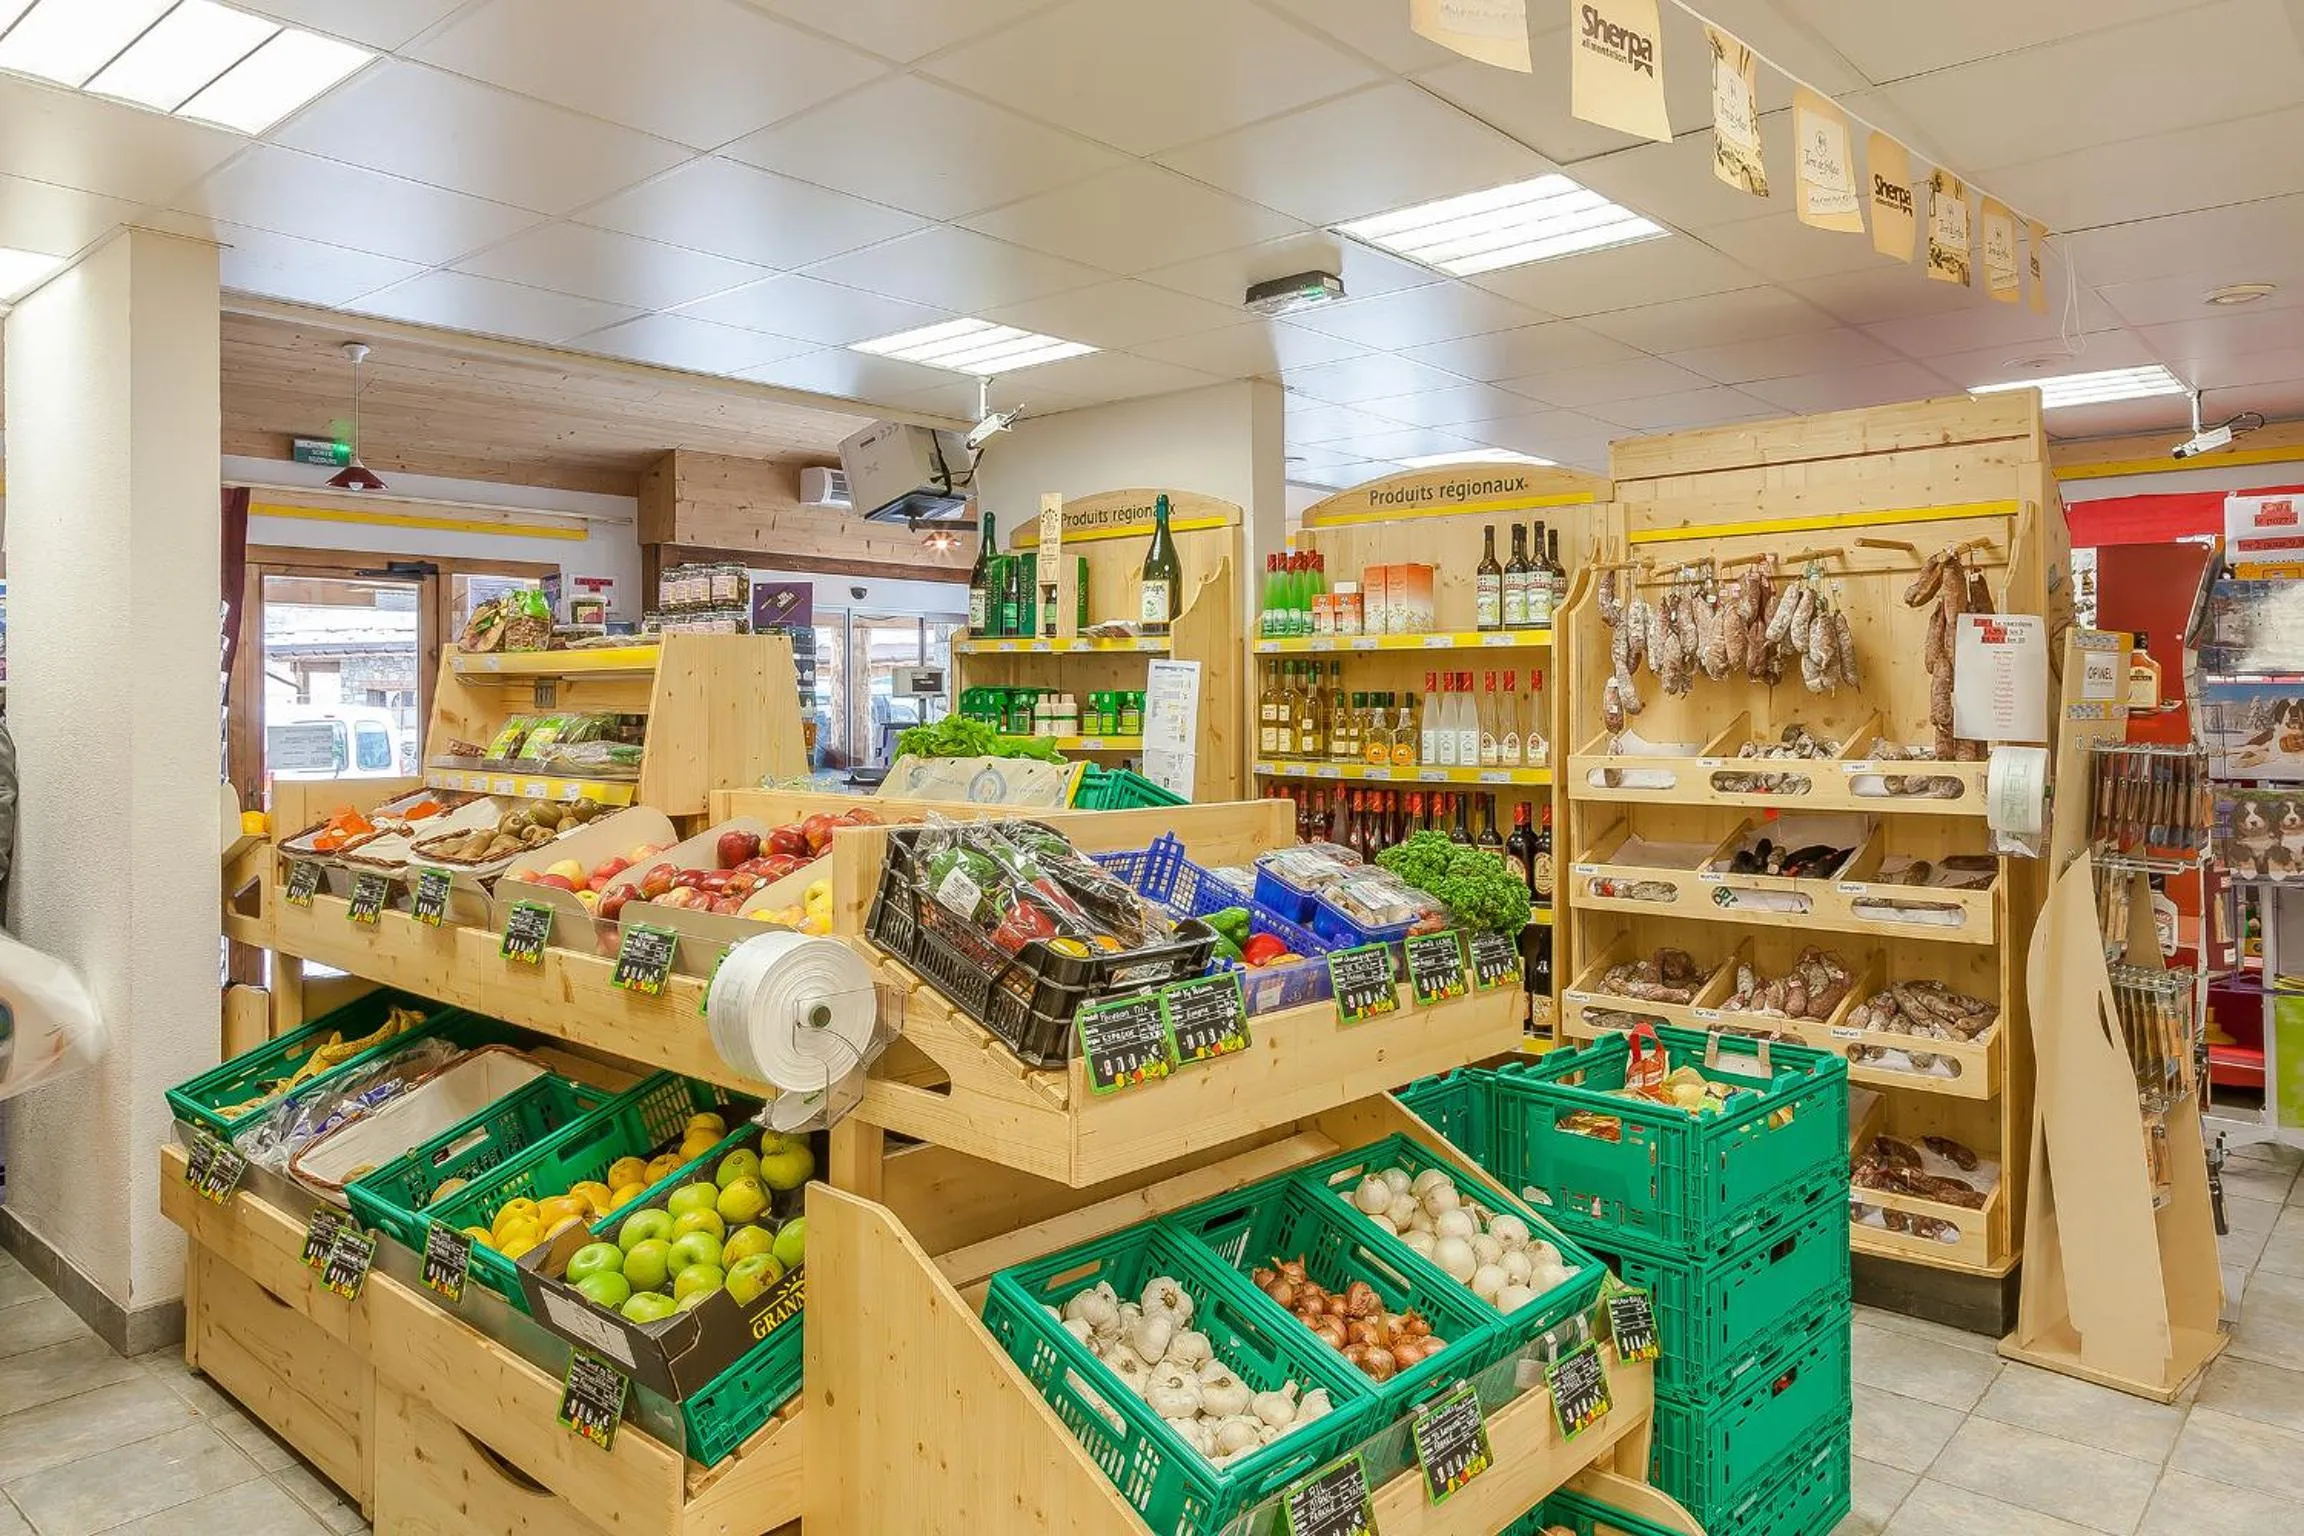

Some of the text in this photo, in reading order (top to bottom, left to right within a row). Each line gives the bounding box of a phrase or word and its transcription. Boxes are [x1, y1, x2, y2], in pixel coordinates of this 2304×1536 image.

[1581, 4, 1653, 64] Sherpa
[1874, 173, 1912, 207] Sherpa
[1369, 477, 1525, 506] Produits régionaux
[1061, 502, 1176, 527] Produits régionax
